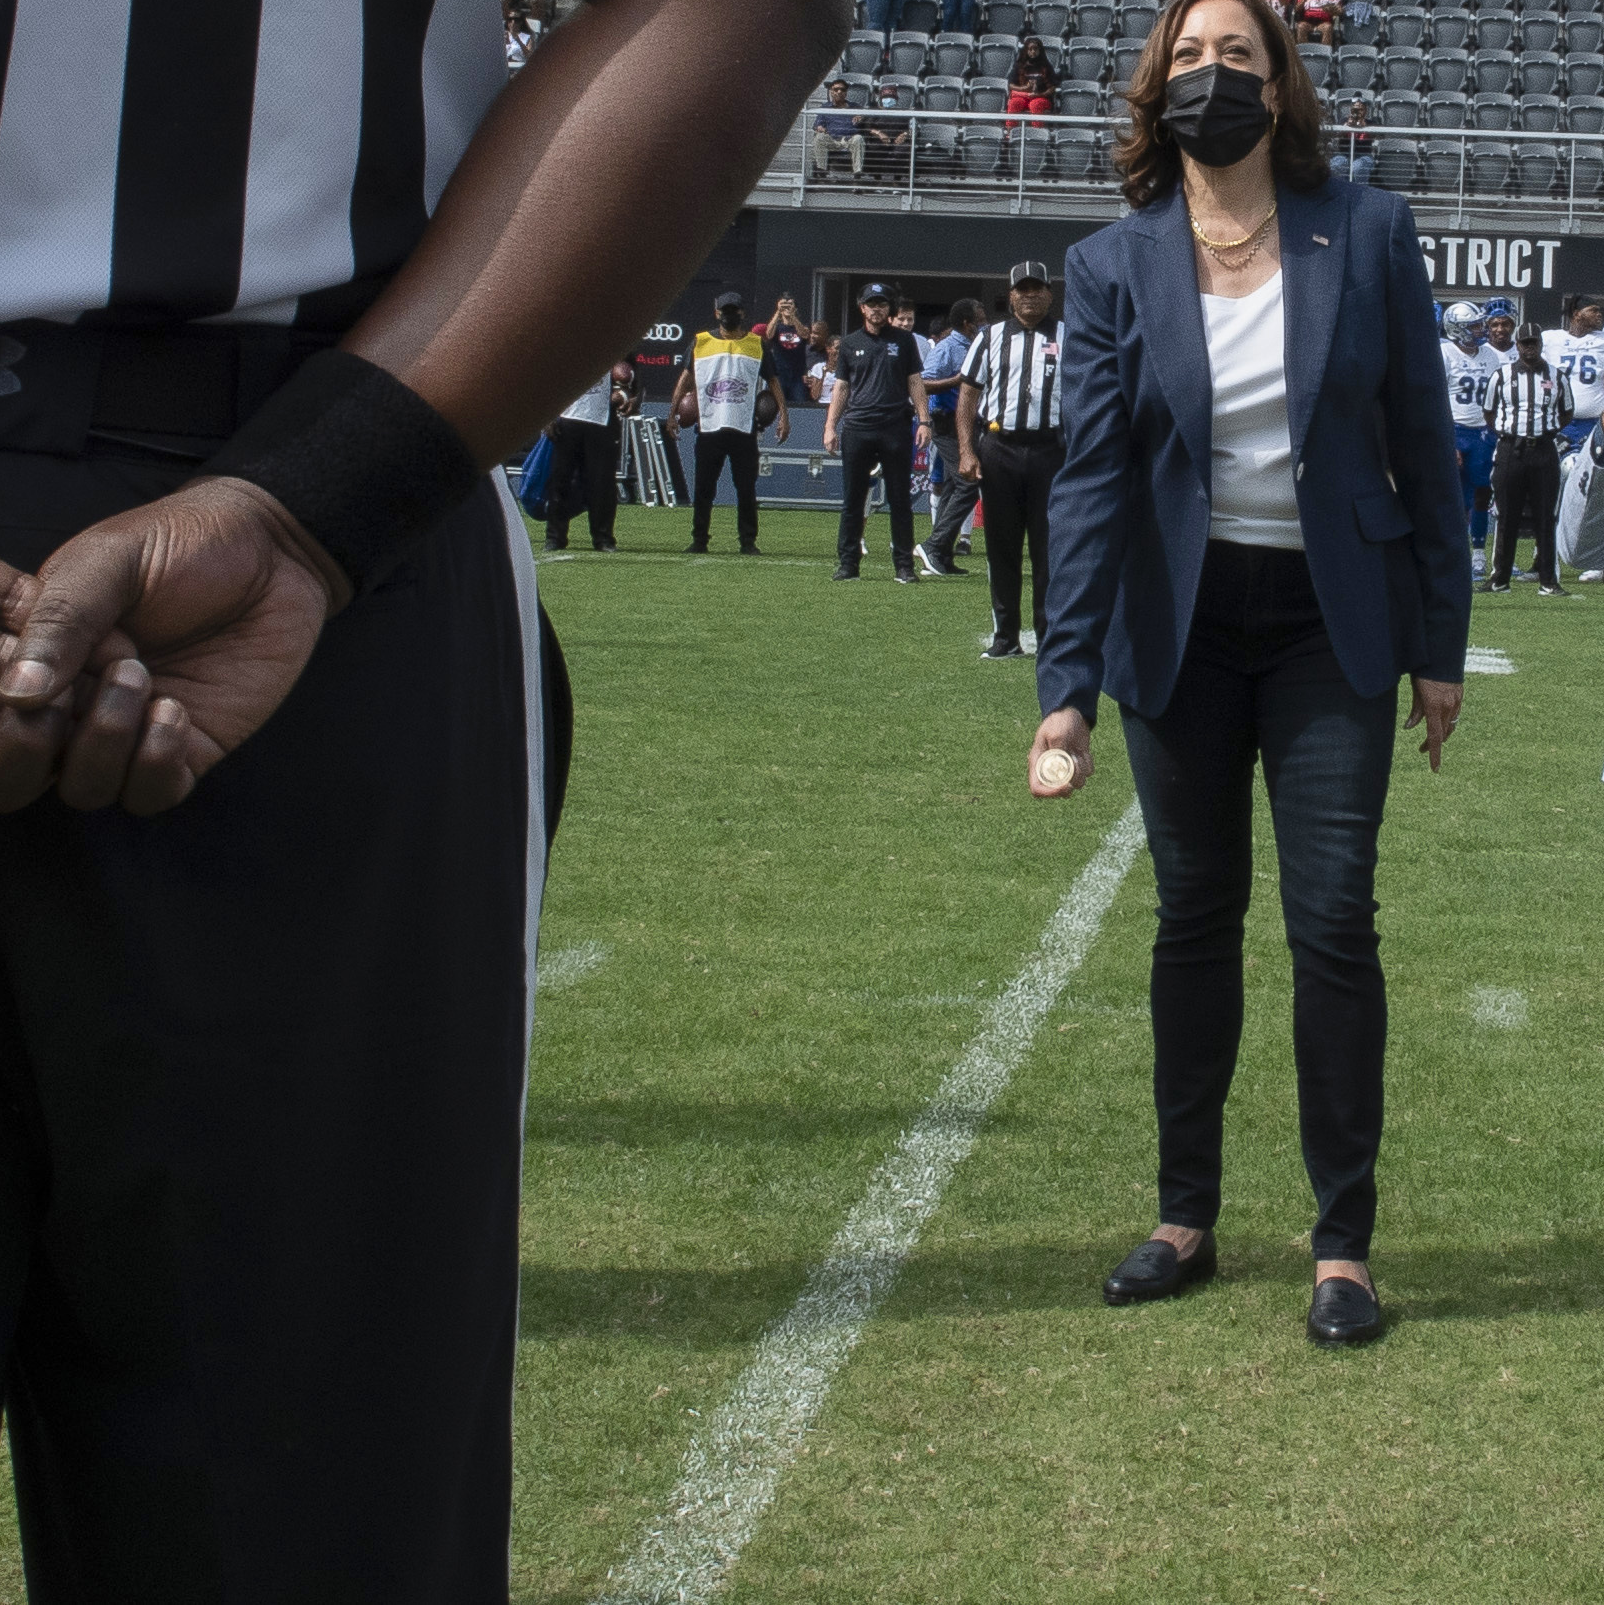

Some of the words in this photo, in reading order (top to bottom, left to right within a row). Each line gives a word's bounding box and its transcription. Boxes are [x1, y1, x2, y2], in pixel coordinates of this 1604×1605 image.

[1417, 235, 1562, 289] STRICT
[635, 354, 671, 366] Audi
[1560, 354, 1598, 385] 76
